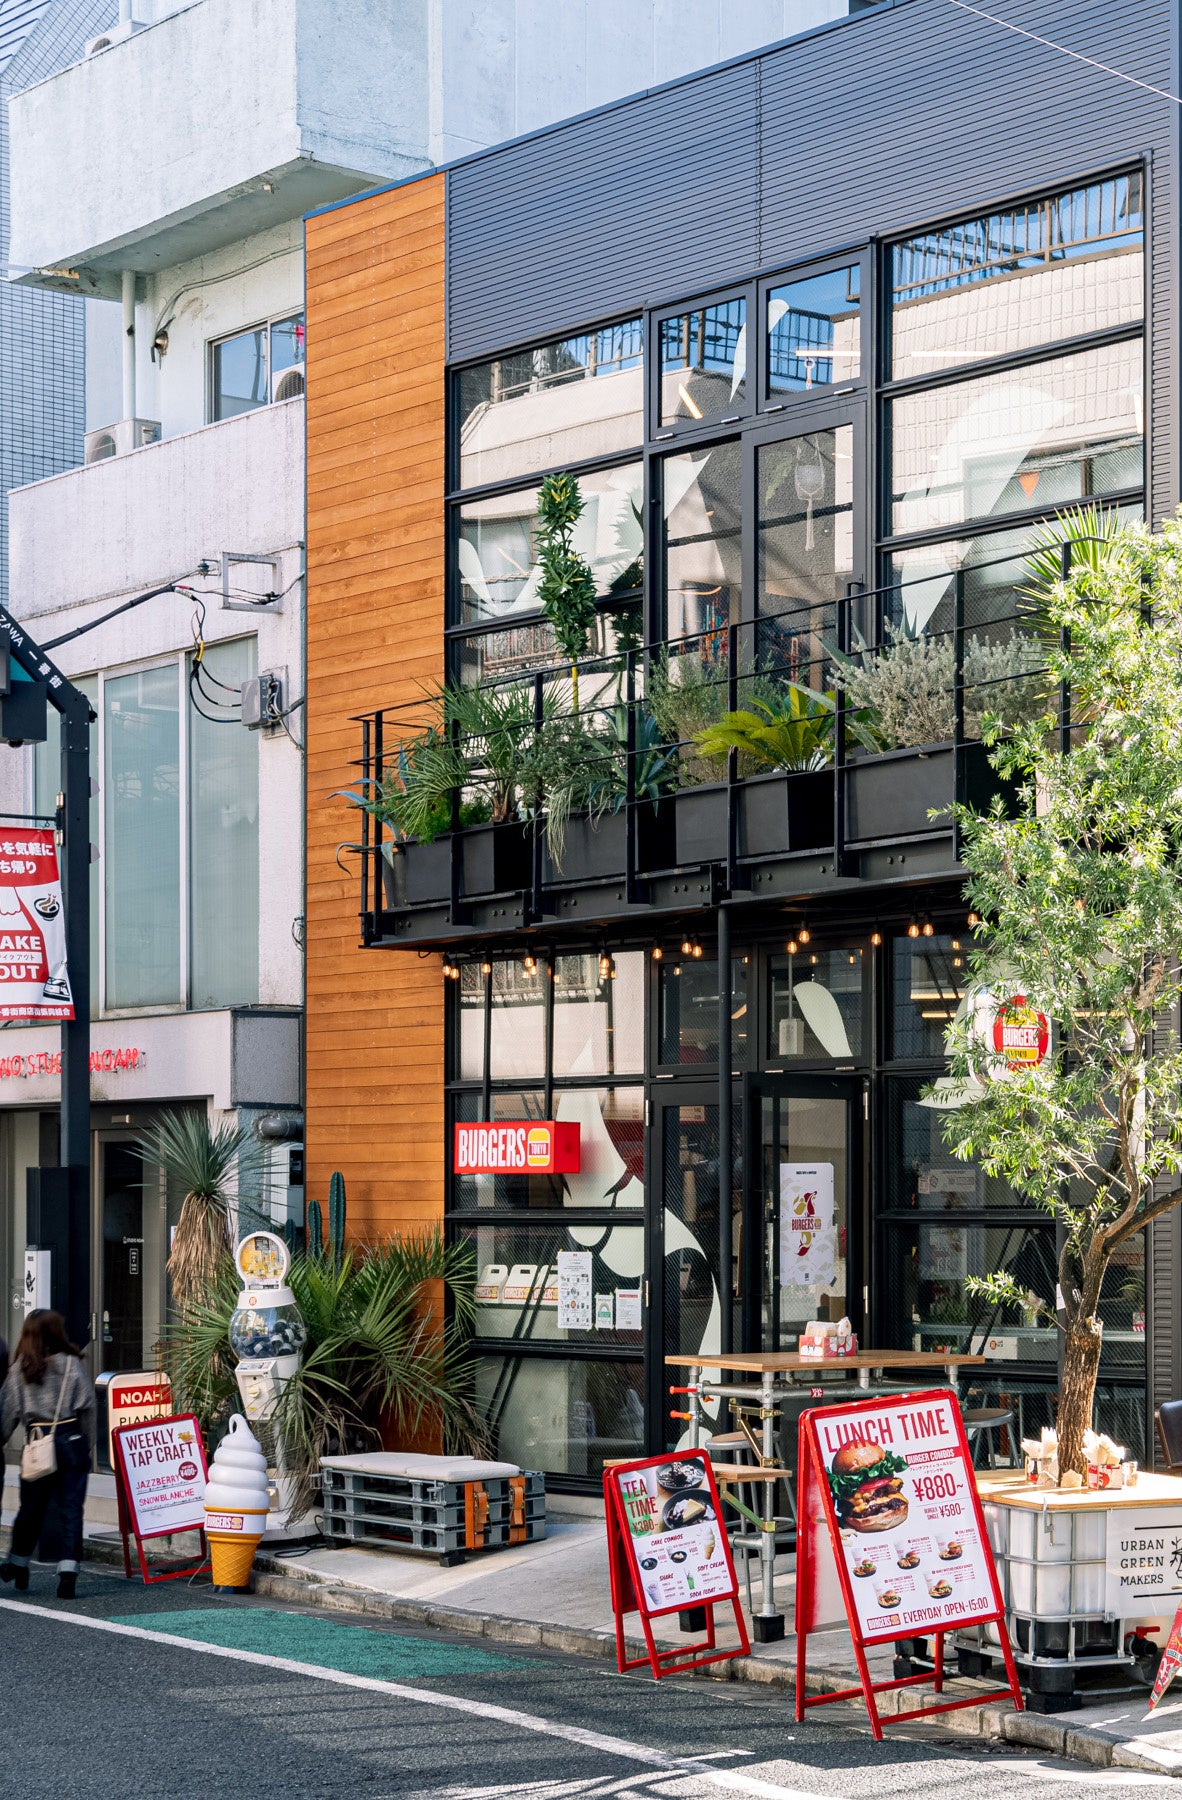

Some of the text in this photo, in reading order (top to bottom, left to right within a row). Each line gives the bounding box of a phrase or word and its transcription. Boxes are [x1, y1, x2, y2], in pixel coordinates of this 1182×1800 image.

[28, 650, 63, 689] 一番街
[0, 841, 54, 856] を気軽に
[0, 953, 35, 961] イクアウト
[1003, 1027, 1039, 1047] BURGERS
[458, 1128, 526, 1167] BURGERS
[791, 1218, 814, 1231] BURGERS
[120, 1390, 163, 1405] NOAH
[120, 1413, 164, 1426] PIAN
[824, 1408, 949, 1453] LUNCH TIME
[126, 1428, 174, 1451] WEEKLY
[129, 1442, 193, 1468] TAP CRAFT
[906, 1448, 955, 1465] BURGER COMBOS
[136, 1474, 180, 1490] JAZZBERRY
[623, 1478, 649, 1498] TEA
[139, 1488, 195, 1506] SNOWBLANCHE
[627, 1496, 659, 1518] TIME
[1120, 1539, 1164, 1551] URBAN
[1120, 1556, 1164, 1569] GREEN
[1120, 1573, 1164, 1586] MAKERS
[903, 1606, 942, 1624] EVERYDAY
